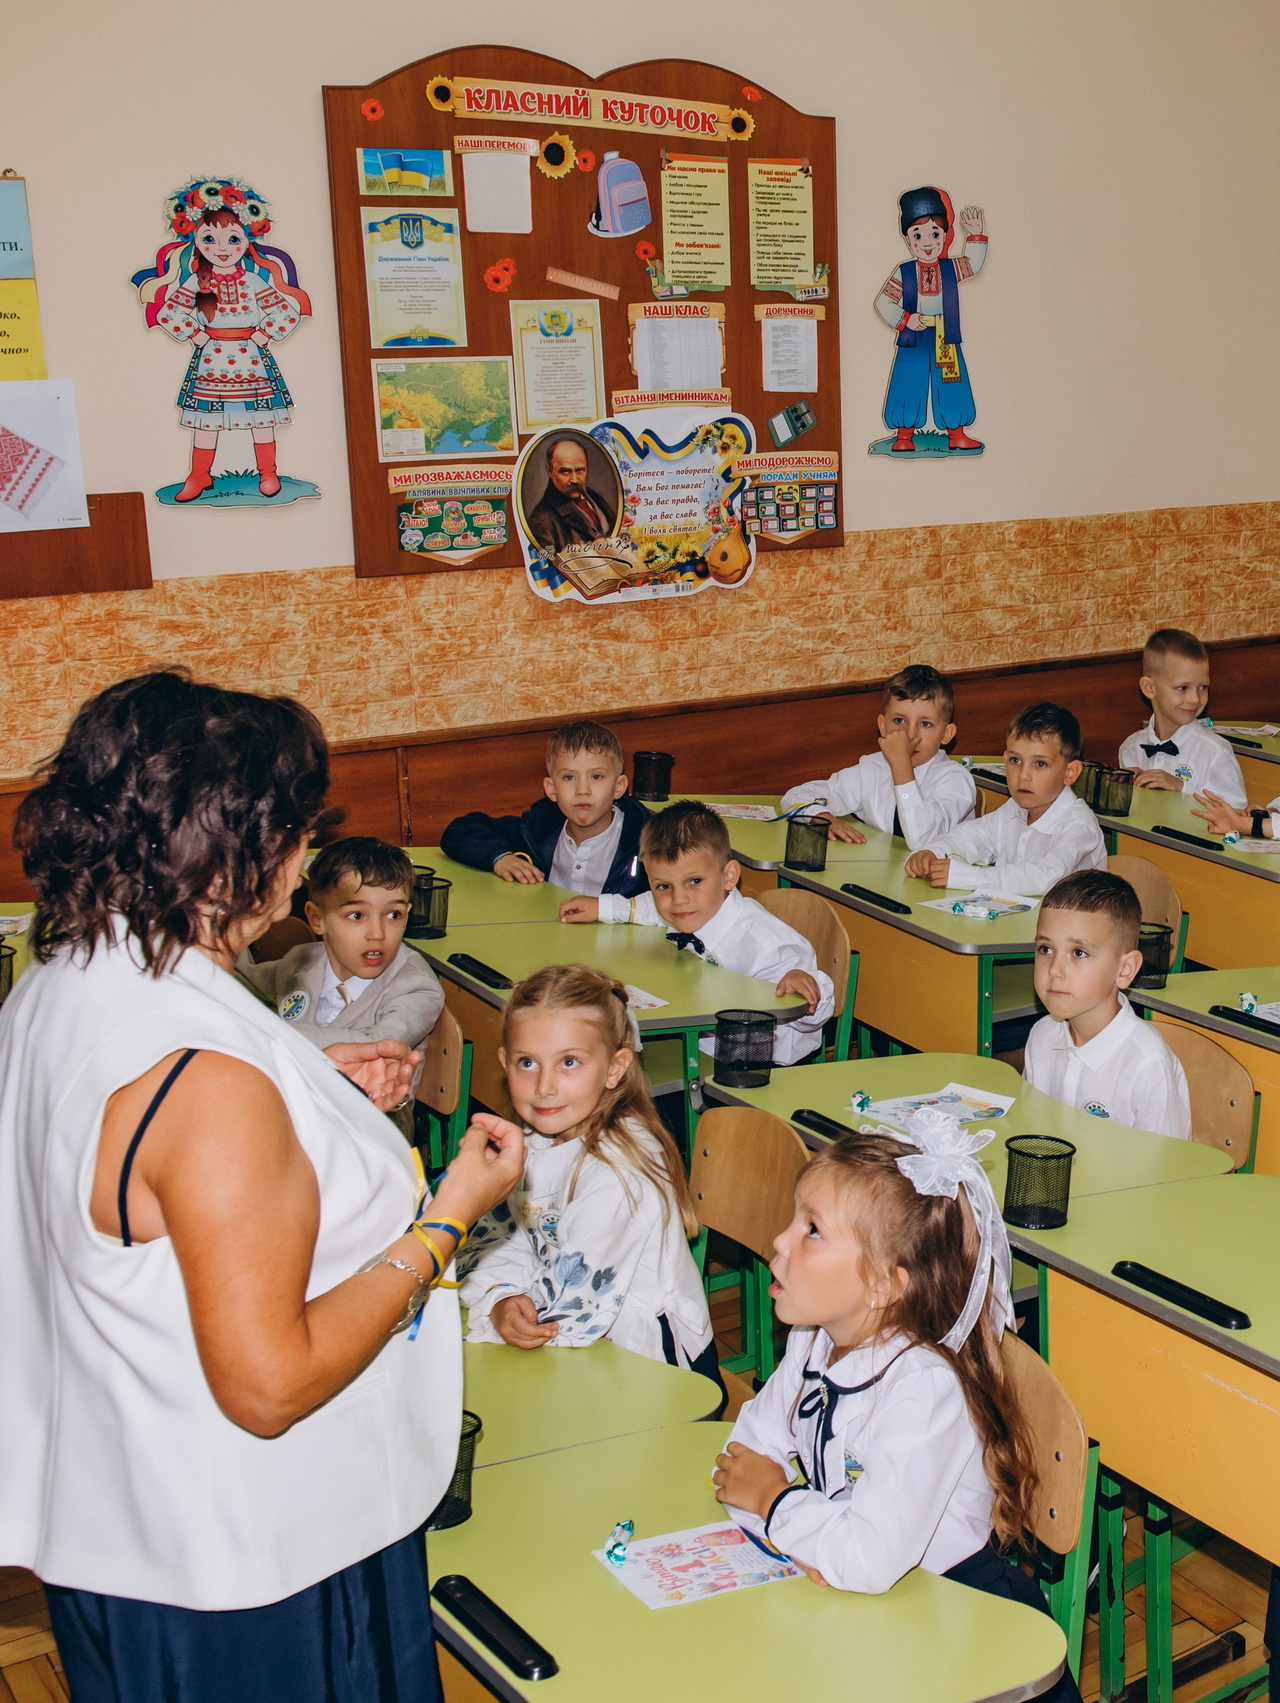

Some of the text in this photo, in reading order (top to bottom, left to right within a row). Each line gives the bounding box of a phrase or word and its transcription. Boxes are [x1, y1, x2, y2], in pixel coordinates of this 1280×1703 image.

[464, 87, 718, 135] КЛАСНИЙ КУТОЧОК
[457, 139, 534, 151] НАШІ ПЕРЕМОГИ
[643, 305, 708, 316] НАШ КЛАС
[766, 308, 814, 317] ДОРУЧЕННЯ
[615, 392, 728, 405] ВІТАННЯ ІМЕНИННИКАМ
[737, 457, 832, 469] МИ ПОДОРОЖУЄМО
[676, 466, 716, 476] поборете!
[393, 471, 513, 486] МИ РОЗВАЖАЄМОСЬ
[760, 472, 837, 482] ПОРАДИ УЧНЯМ
[408, 486, 510, 497] ГАЛЯВИНА ВВІЧЛИВИХ СЛІВ
[636, 484, 653, 492] Вам
[656, 483, 669, 492] Бог
[644, 496, 701, 506] За вас правда,
[648, 510, 698, 522] за вас слава
[650, 526, 667, 535] воля
[671, 1559, 707, 1573] 1
